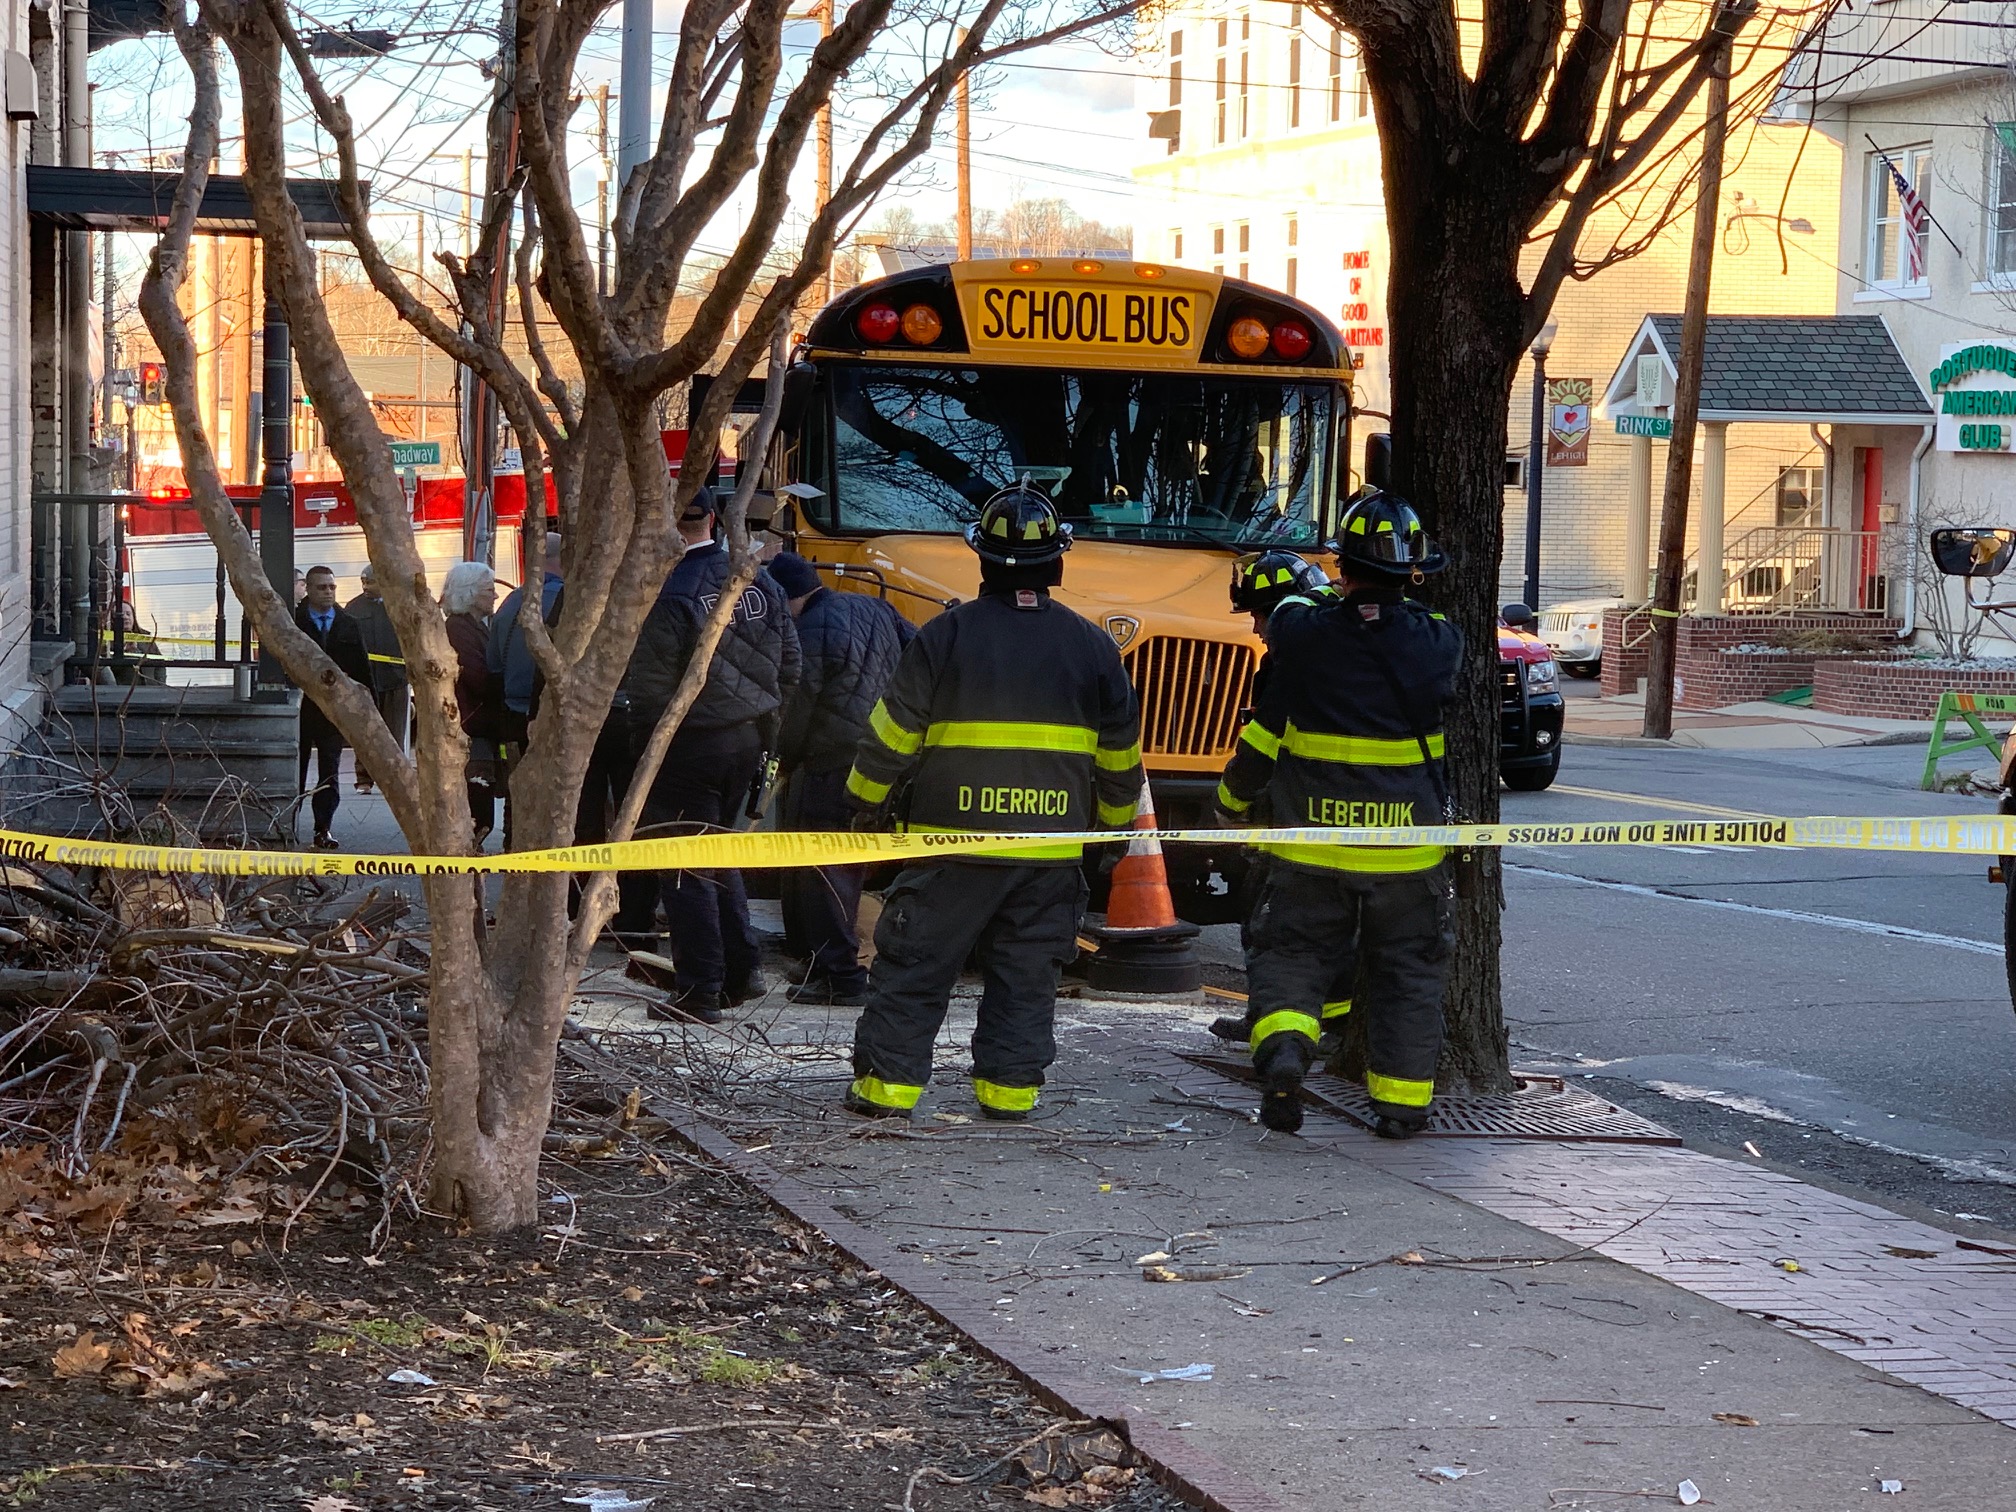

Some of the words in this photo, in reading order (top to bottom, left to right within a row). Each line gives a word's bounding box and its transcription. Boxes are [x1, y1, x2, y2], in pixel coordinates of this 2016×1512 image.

[1343, 251, 1369, 269] HOME
[1350, 277, 1361, 295] OF
[983, 288, 1118, 342] SCHOOL
[1124, 295, 1190, 346] BUS
[1342, 303, 1368, 321] GOOD
[1620, 417, 1653, 435] RINK
[1656, 420, 1667, 431] ST
[1960, 424, 2001, 449] CLUB
[393, 446, 434, 463] oadway
[1551, 451, 1585, 460] LEHIGH
[959, 786, 973, 812] D
[980, 787, 1069, 816] DERRICO
[1507, 826, 1574, 844] CROSS
[1579, 825, 1622, 843] NOT
[1628, 824, 1656, 843] DO
[1662, 823, 1708, 843] LINE
[1713, 821, 1787, 843] POLICE
[1869, 820, 1912, 847] NOT
[1920, 820, 1949, 849] DO
[1957, 821, 2004, 851] LINE
